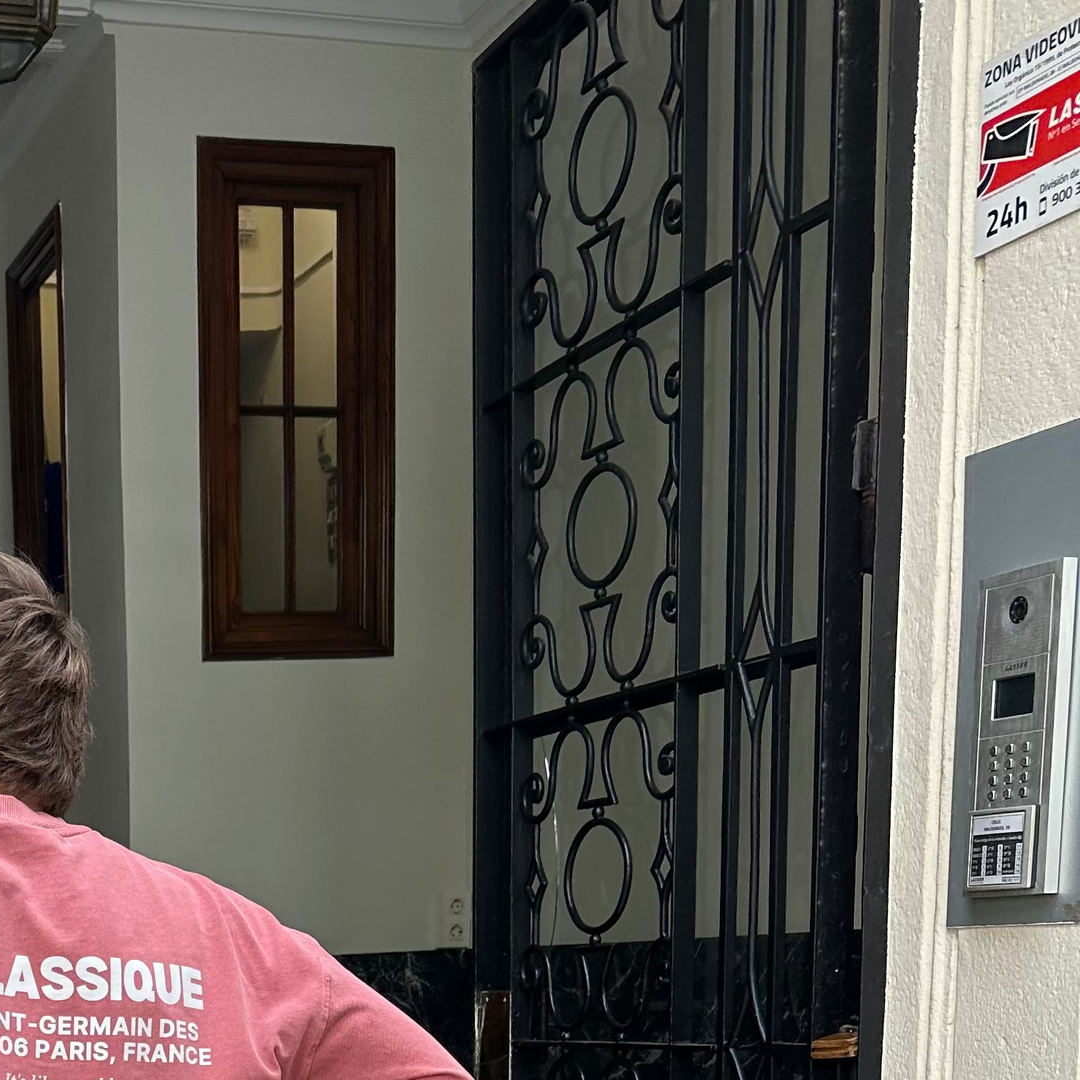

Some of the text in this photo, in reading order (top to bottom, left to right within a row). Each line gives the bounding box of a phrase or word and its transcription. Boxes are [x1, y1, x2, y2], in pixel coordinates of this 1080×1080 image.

[984, 53, 1021, 88] ZONA
[1048, 91, 1080, 129] LAS
[1071, 117, 1080, 129] Se
[1039, 173, 1069, 194] División
[1070, 168, 1080, 179] de
[986, 195, 1028, 239] 24h
[1052, 185, 1073, 206] 900
[1075, 181, 1080, 195] 3
[159, 1018, 199, 1041] DES
[36, 1040, 116, 1065] PARIS,
[123, 1043, 212, 1066] FRANCE
